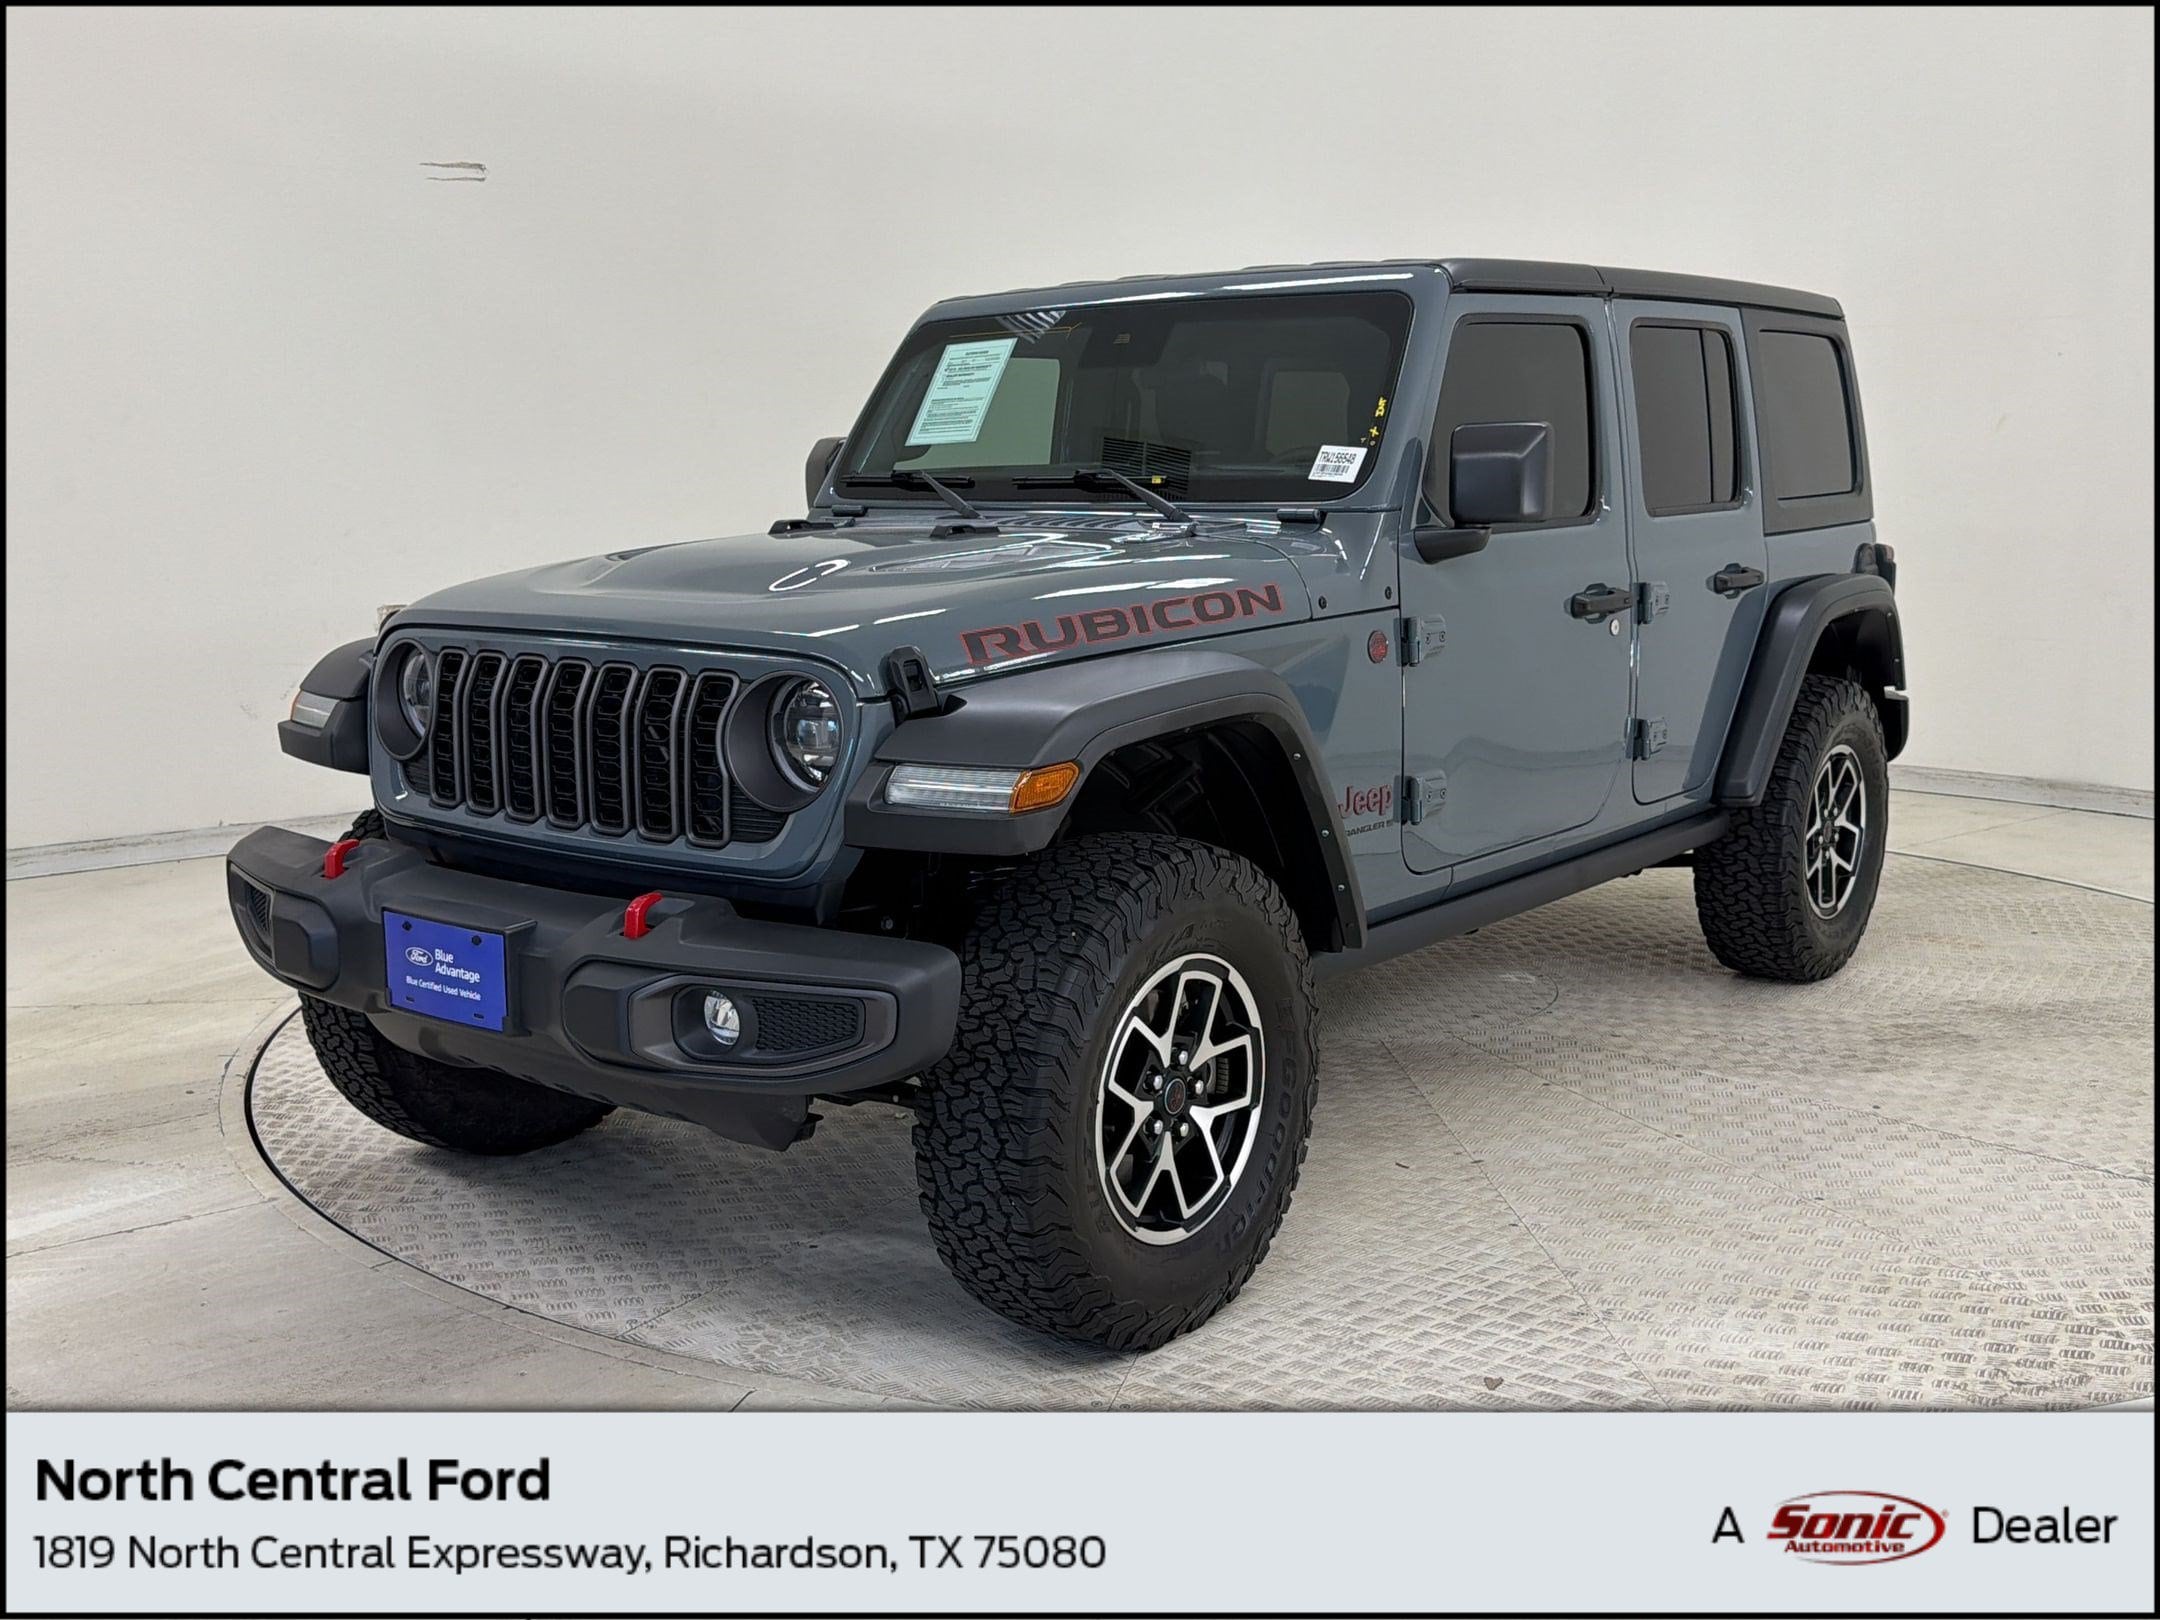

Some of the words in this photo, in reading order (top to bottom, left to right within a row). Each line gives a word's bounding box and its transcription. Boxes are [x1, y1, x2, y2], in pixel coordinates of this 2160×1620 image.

[960, 584, 1284, 664] RUBICON
[1338, 784, 1392, 819] Jeep
[435, 948, 454, 963] Blue
[435, 962, 480, 983] Advantage
[406, 975, 418, 987] Blue
[418, 978, 442, 992] Certified
[442, 984, 459, 996] Used
[459, 988, 481, 1001] Vehicle
